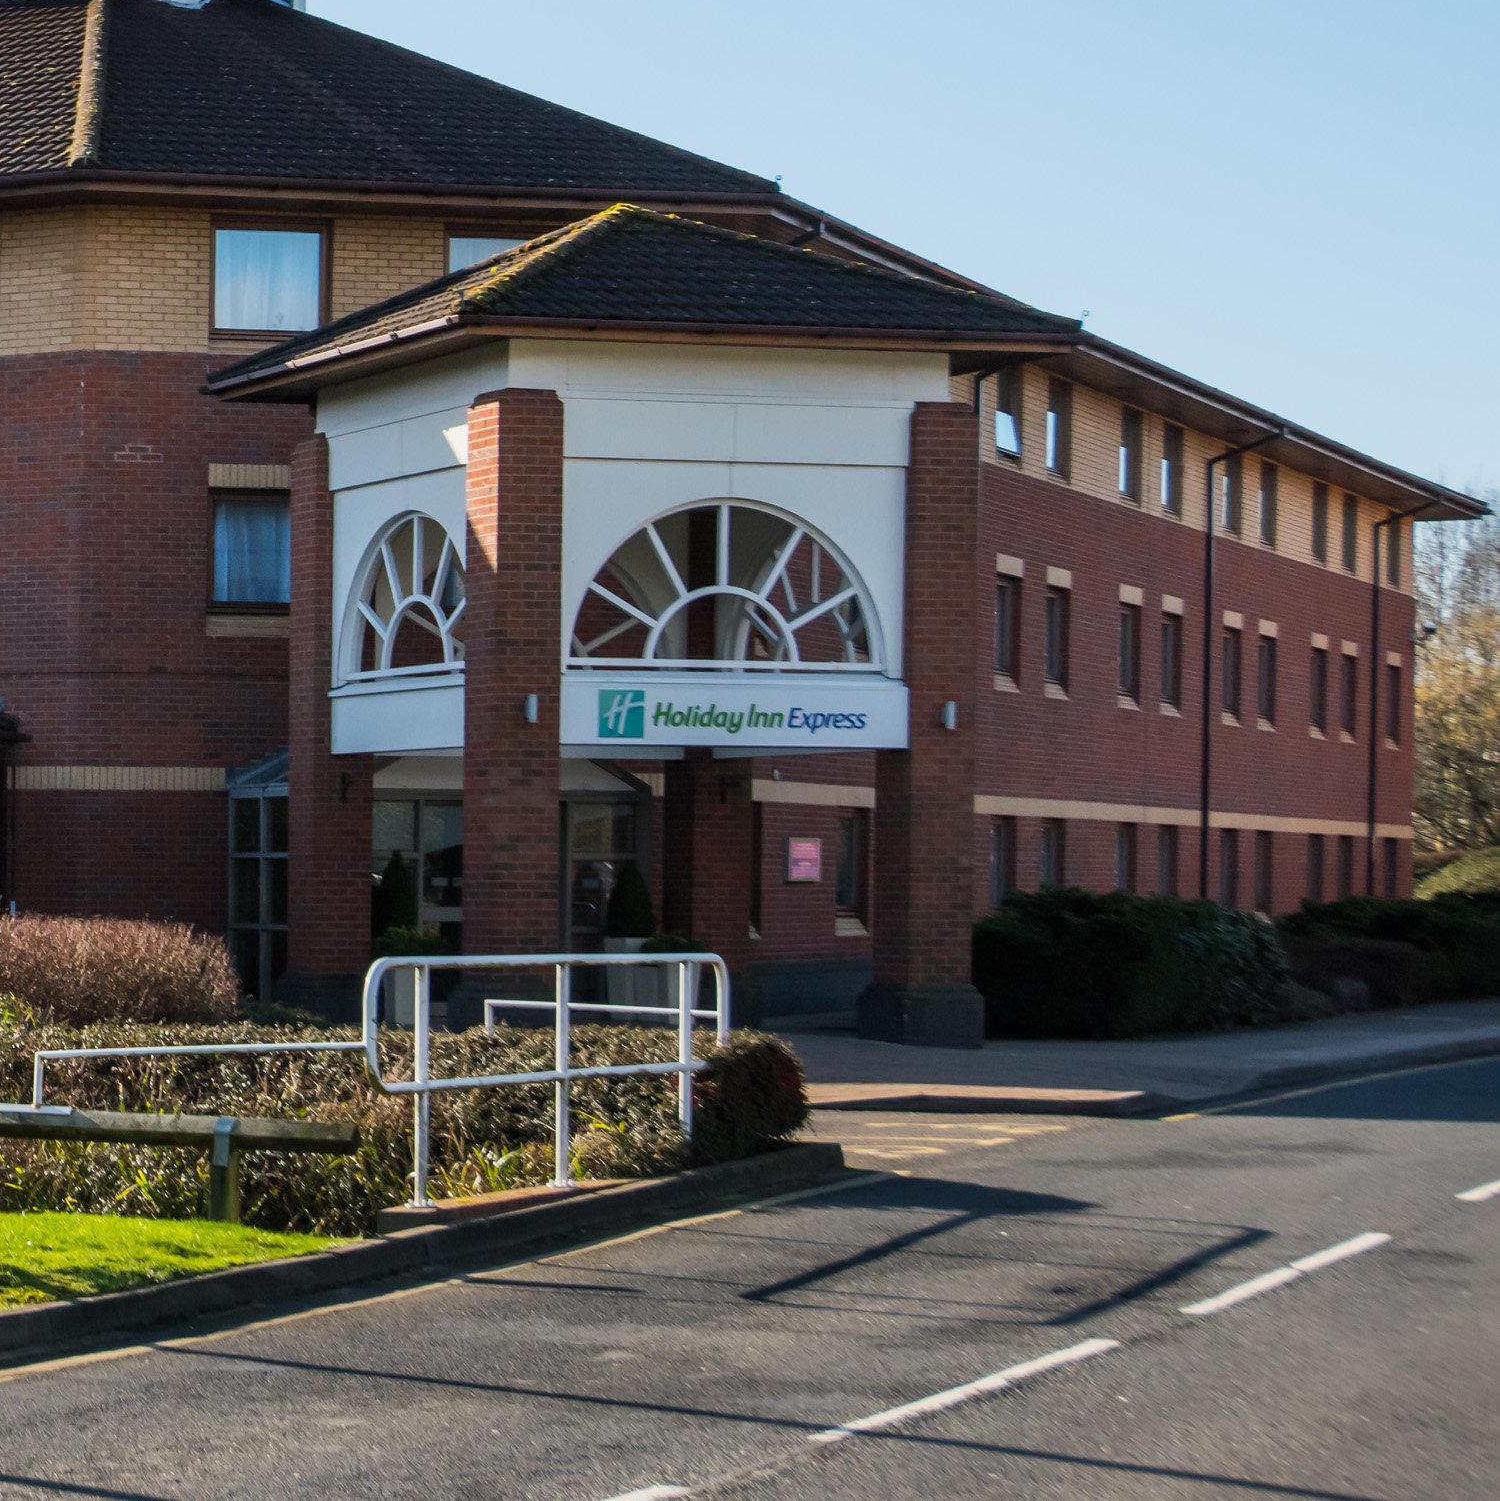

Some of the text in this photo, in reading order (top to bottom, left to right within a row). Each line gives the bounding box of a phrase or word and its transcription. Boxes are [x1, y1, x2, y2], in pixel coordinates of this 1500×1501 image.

[652, 701, 868, 734] Holiday Inn Express
